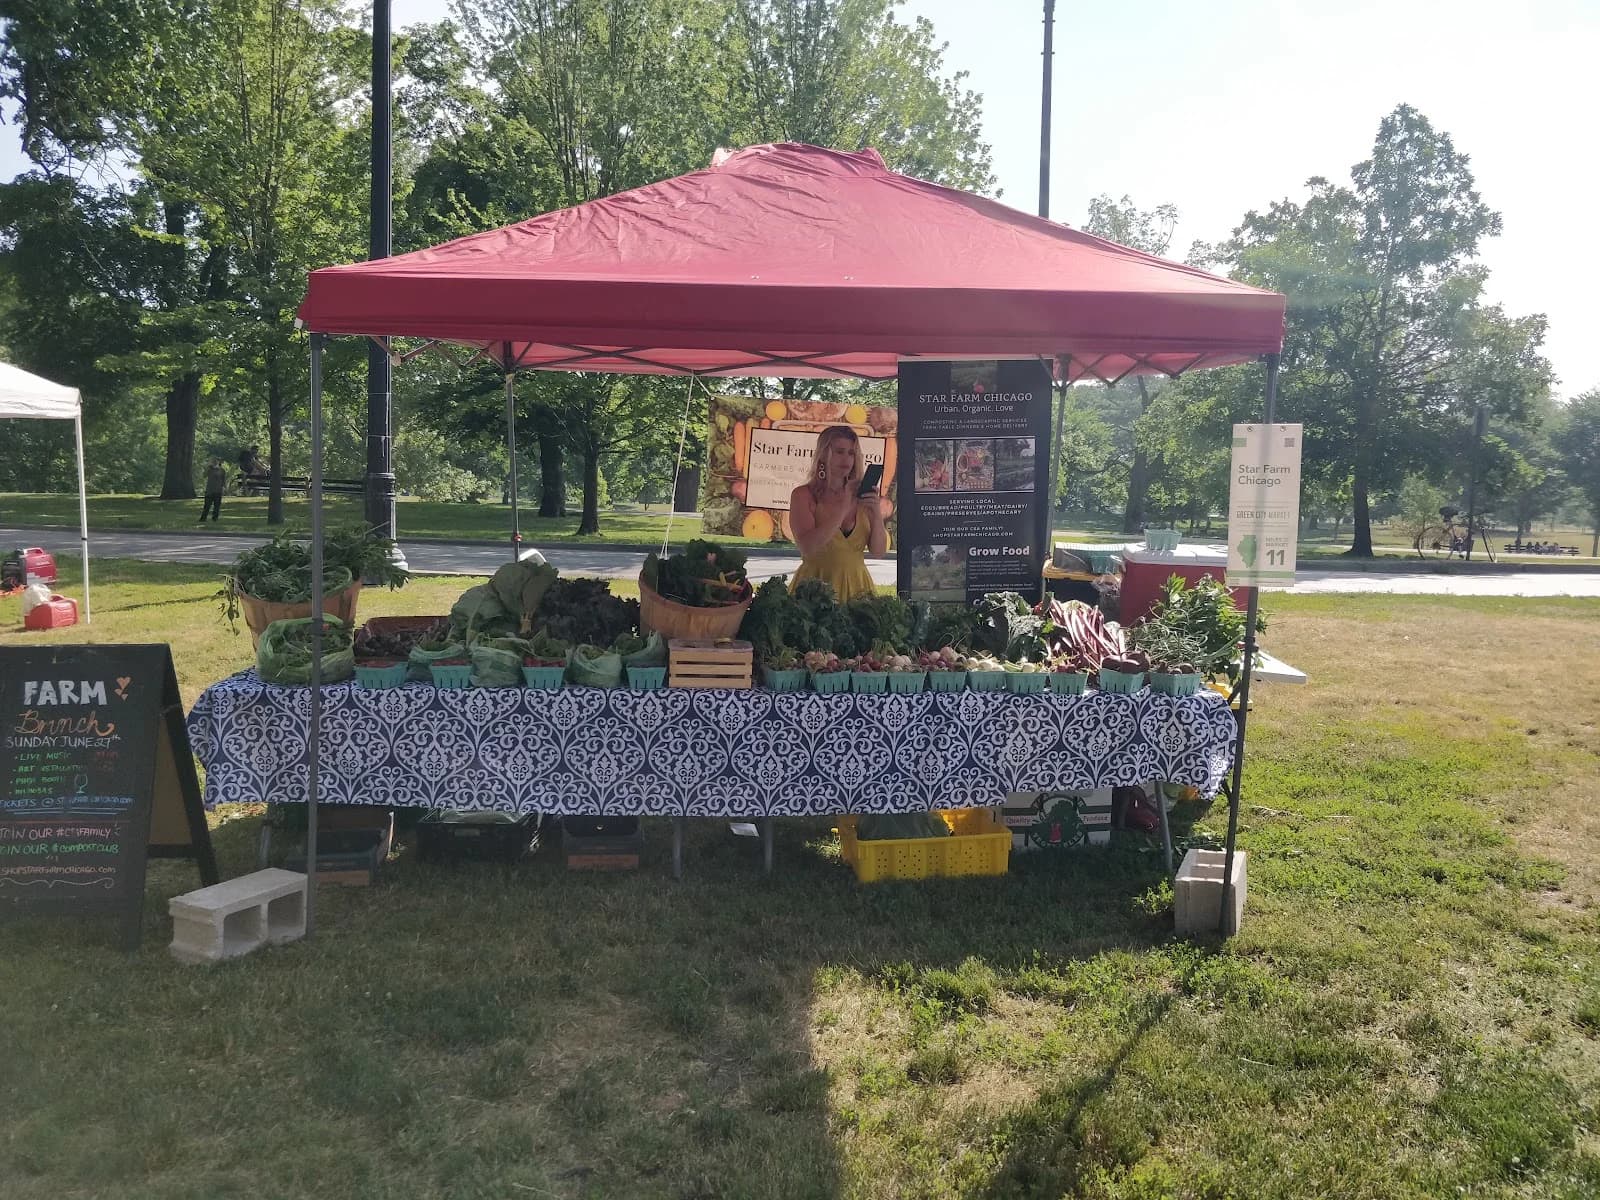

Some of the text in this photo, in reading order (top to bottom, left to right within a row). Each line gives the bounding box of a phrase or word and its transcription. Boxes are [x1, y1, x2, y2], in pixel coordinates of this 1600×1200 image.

[919, 393, 1033, 403] STAR FARM CHICAGO
[752, 442, 783, 455] Star
[1238, 464, 1291, 474] Star Farm
[1238, 475, 1281, 488] Chicago
[968, 545, 1030, 556] Grow Food
[1265, 549, 1285, 565] 11
[23, 680, 108, 706] FARM
[14, 709, 116, 737] Brunch
[6, 736, 58, 748] SUNDAY
[60, 736, 94, 749] JUNE
[28, 827, 53, 840] OUR
[0, 843, 22, 856] OIN
[23, 843, 49, 855] OUR
